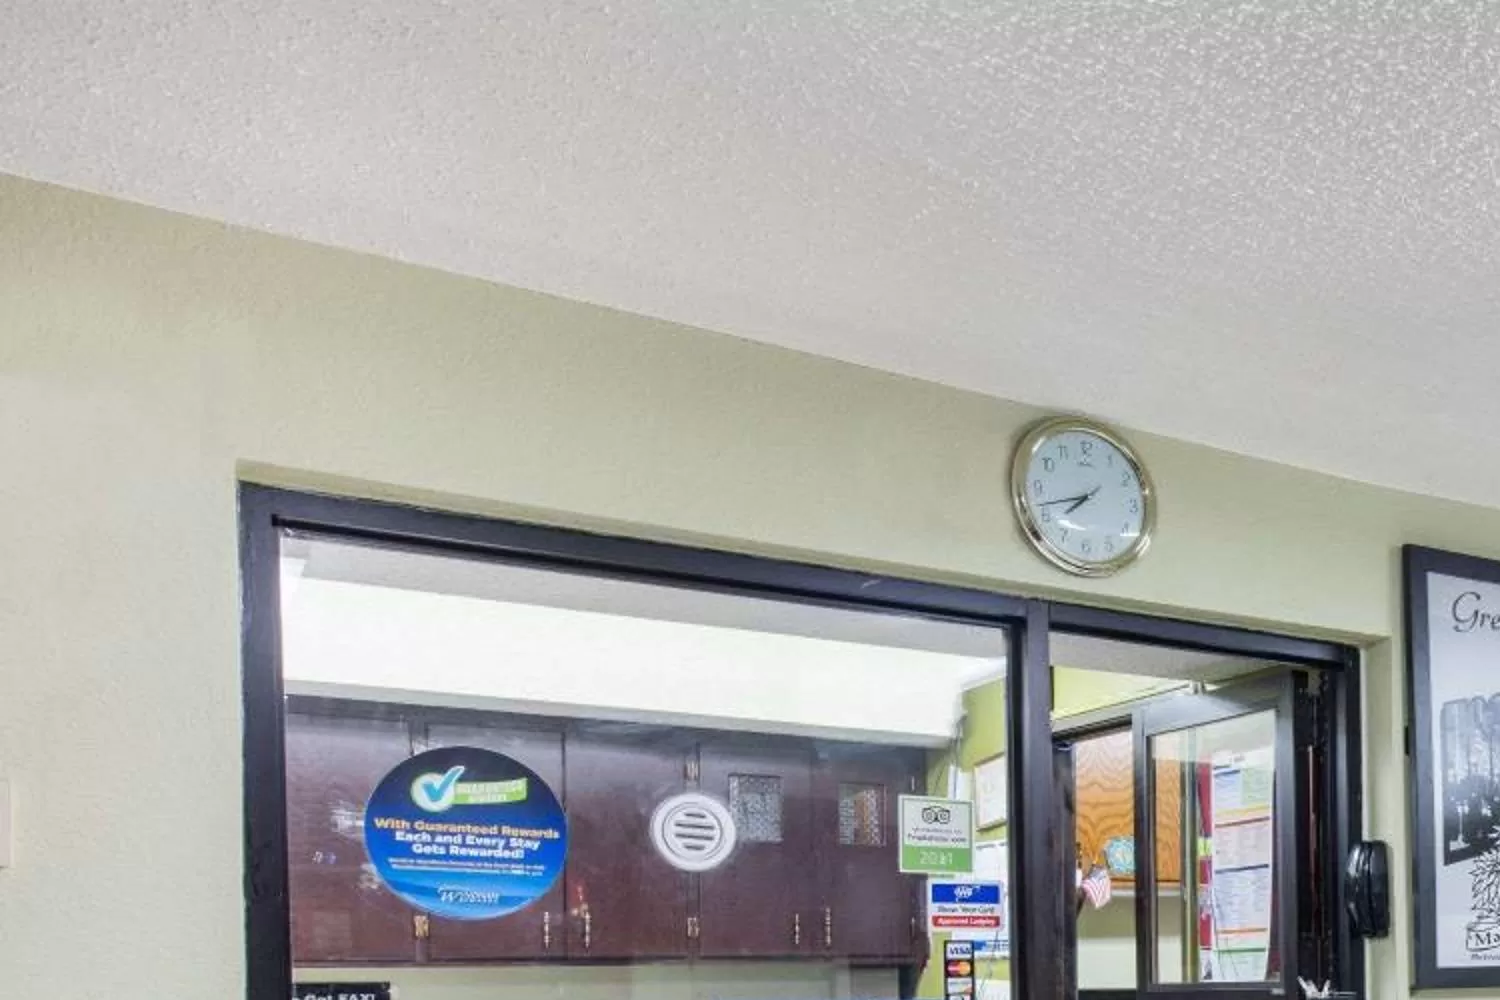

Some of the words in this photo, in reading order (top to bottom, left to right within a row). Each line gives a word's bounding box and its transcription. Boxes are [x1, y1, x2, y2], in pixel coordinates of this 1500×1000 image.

[1057, 445, 1069, 460] 11
[1080, 440, 1093, 457] 12
[1042, 457, 1055, 473] 10
[1106, 456, 1114, 468] 1
[1122, 471, 1132, 487] 2
[1033, 480, 1043, 495] 9
[1041, 507, 1051, 523] 8
[1128, 499, 1139, 515] 3
[1059, 528, 1069, 543] 7
[1081, 539, 1092, 554] 6
[1104, 536, 1114, 553] 5
[372, 817, 409, 831] With
[412, 819, 498, 836] Guaranteed
[500, 824, 560, 839] Rewards
[394, 831, 430, 843] Each
[434, 833, 461, 845] and
[464, 834, 505, 850] Every
[508, 837, 540, 851] Stay
[411, 843, 445, 856] Gets
[448, 845, 524, 860] Rewarded!
[949, 947, 972, 956] VISA
